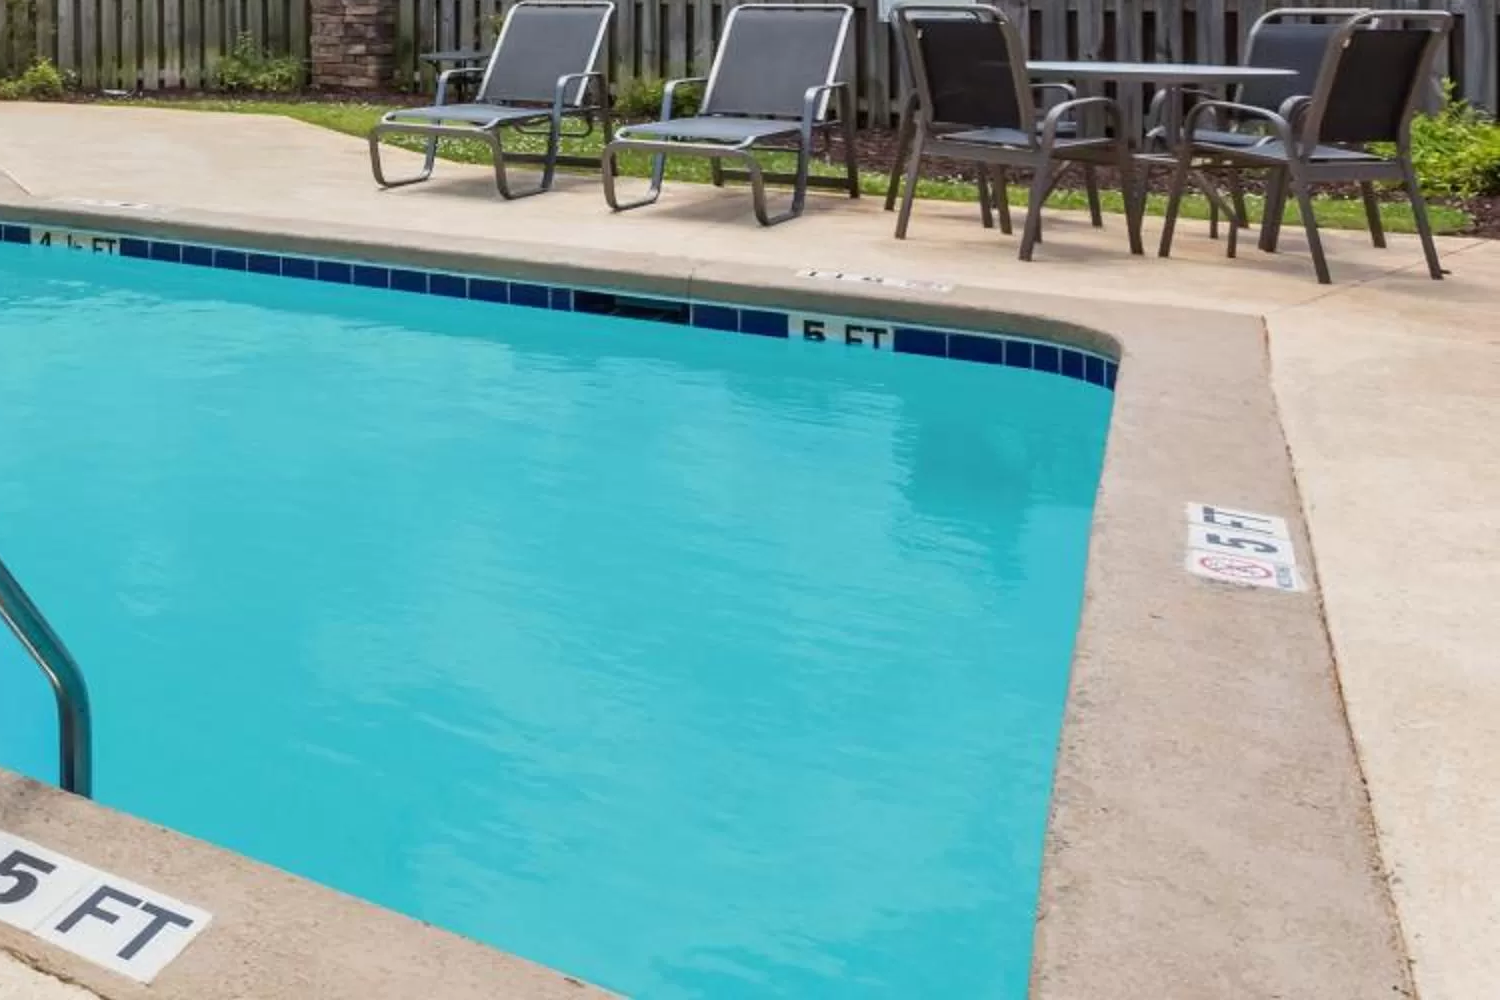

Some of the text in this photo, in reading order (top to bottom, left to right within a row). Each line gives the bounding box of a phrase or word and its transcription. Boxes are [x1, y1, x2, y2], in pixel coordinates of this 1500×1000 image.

[92, 237, 117, 256] FT
[802, 319, 889, 350] 5 FT
[1203, 507, 1278, 553] 5 FT
[54, 884, 195, 961] FT
